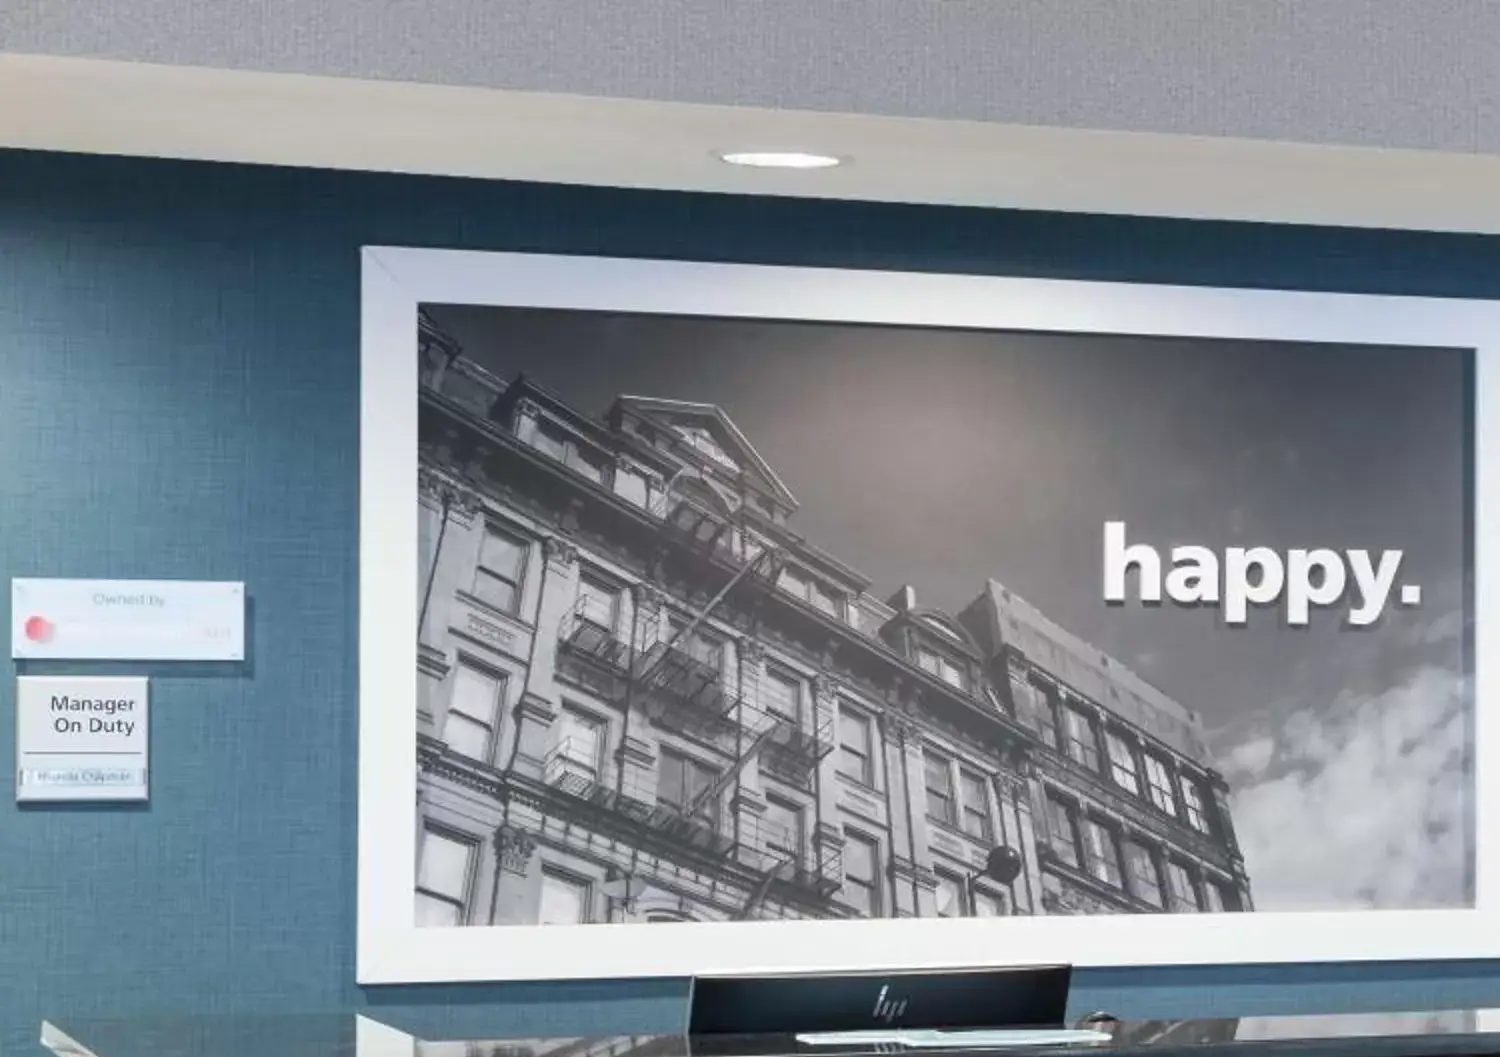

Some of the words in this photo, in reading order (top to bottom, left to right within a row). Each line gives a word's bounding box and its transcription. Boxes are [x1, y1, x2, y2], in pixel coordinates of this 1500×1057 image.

[1103, 521, 1421, 624] happy.
[51, 696, 135, 715] Manager
[54, 719, 82, 733] On
[89, 717, 135, 737] Duty
